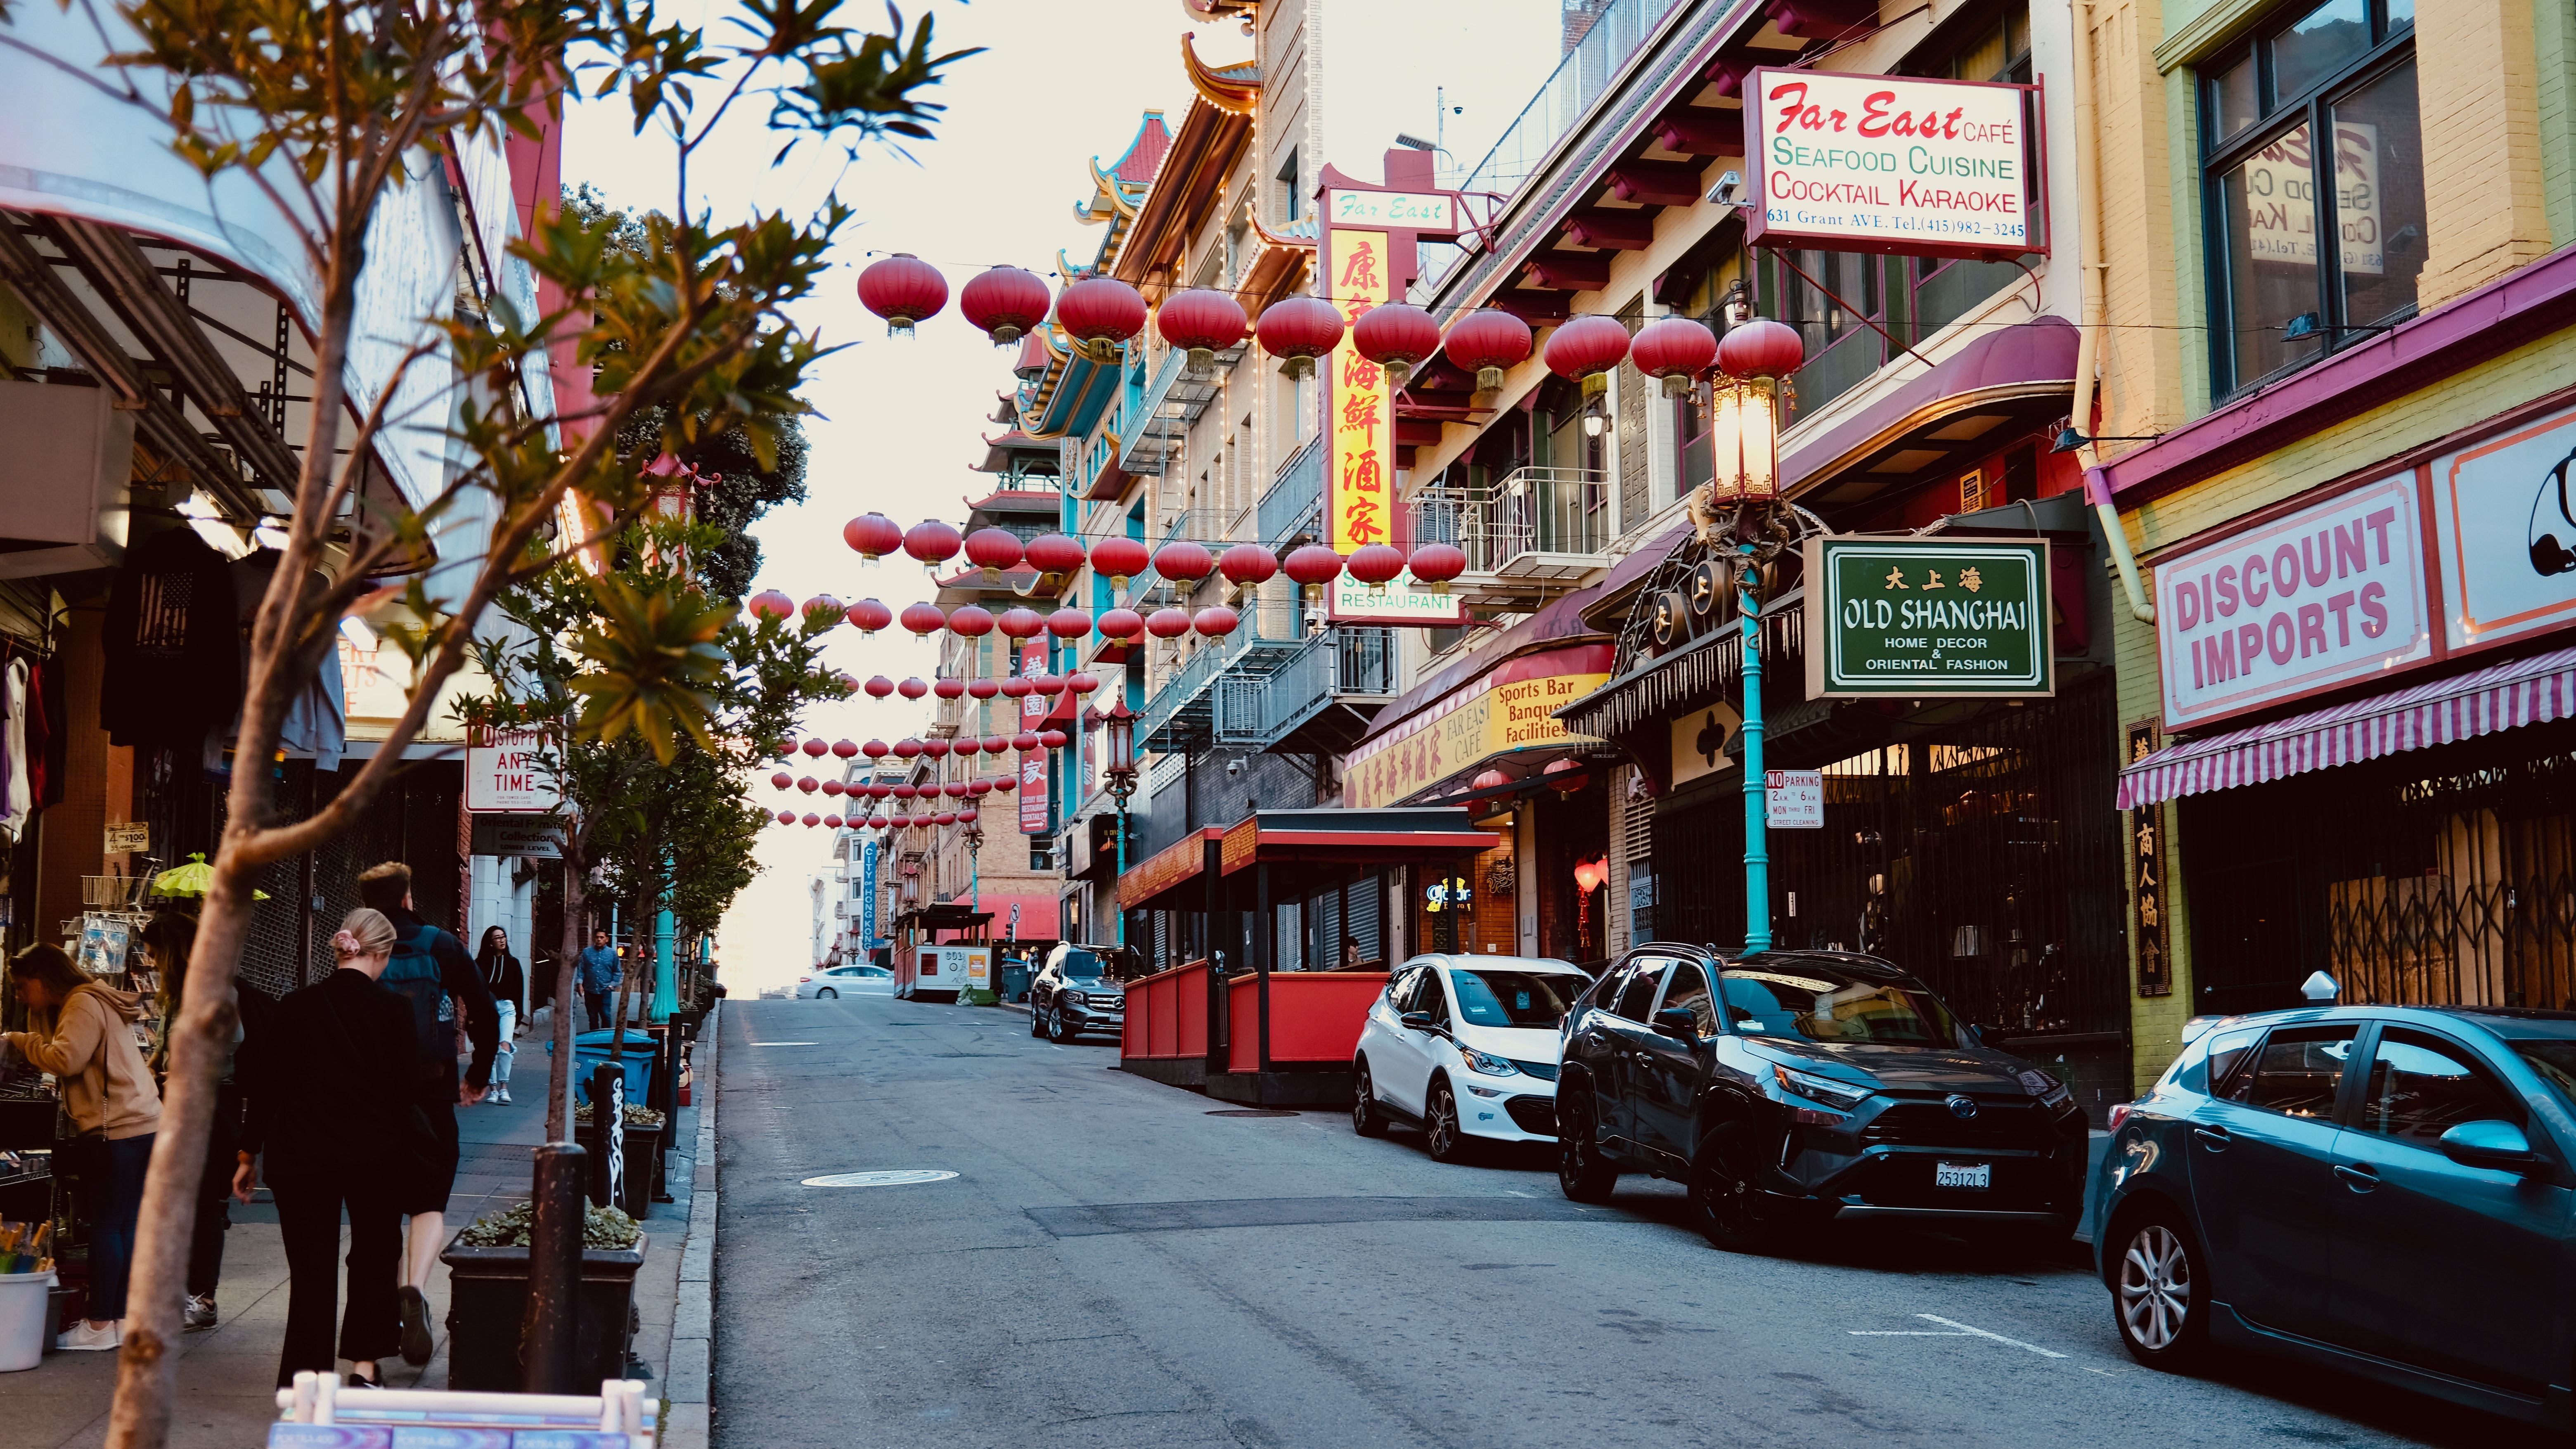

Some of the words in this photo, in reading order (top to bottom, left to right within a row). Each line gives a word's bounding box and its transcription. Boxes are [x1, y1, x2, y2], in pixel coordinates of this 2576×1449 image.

[1769, 83, 1847, 133] Far
[1858, 91, 1963, 140] East
[1963, 119, 2015, 144] CAFÉ
[1773, 136, 1896, 172] SEAFOOD
[1909, 146, 2015, 180] CUISINE
[1771, 170, 1889, 206] COCKTAIL
[1900, 179, 2017, 213] KARAOKE
[1339, 195, 1377, 217] Far
[1389, 197, 1442, 219] East
[1767, 208, 1790, 223] 631
[1798, 211, 1843, 225] Grant
[1851, 214, 1888, 229] AVE.
[2176, 506, 2394, 631] DISCOUNT
[1885, 566, 1982, 593] 大上海
[1342, 594, 1452, 610] RESTAURANT
[1844, 599, 1892, 629] OLD
[1901, 599, 2025, 630] SHANGHAI
[1885, 638, 1927, 648] HOME
[1937, 638, 1987, 649] DECOR
[2192, 582, 2388, 689] IMPORTS
[1866, 659, 1937, 670] ORIENTAL
[1946, 660, 2008, 670] FASHION
[1932, 649, 1941, 659] &
[1499, 683, 1539, 706] Sports
[1547, 679, 1574, 695] Bar
[1447, 716, 1464, 742] FAR
[1466, 697, 1491, 727] EAST
[1507, 721, 1568, 743] Facilities
[1455, 727, 1482, 764] CAFÉ
[497, 753, 533, 769] ANY
[494, 774, 534, 791] TIME
[1768, 773, 1783, 787] NO
[1785, 777, 1819, 786] PARKING
[1773, 791, 1778, 801] 2
[1801, 791, 1806, 801] 6
[1022, 804, 1047, 813] RESTAURANT
[1773, 806, 1786, 814] MON
[1805, 806, 1815, 814] FRI
[480, 817, 523, 828] Oriental
[109, 833, 118, 844] 4
[2133, 736, 2159, 973] 華商人協會
[864, 921, 872, 950] KONG
[1938, 1172, 1987, 1187] 25312L3
